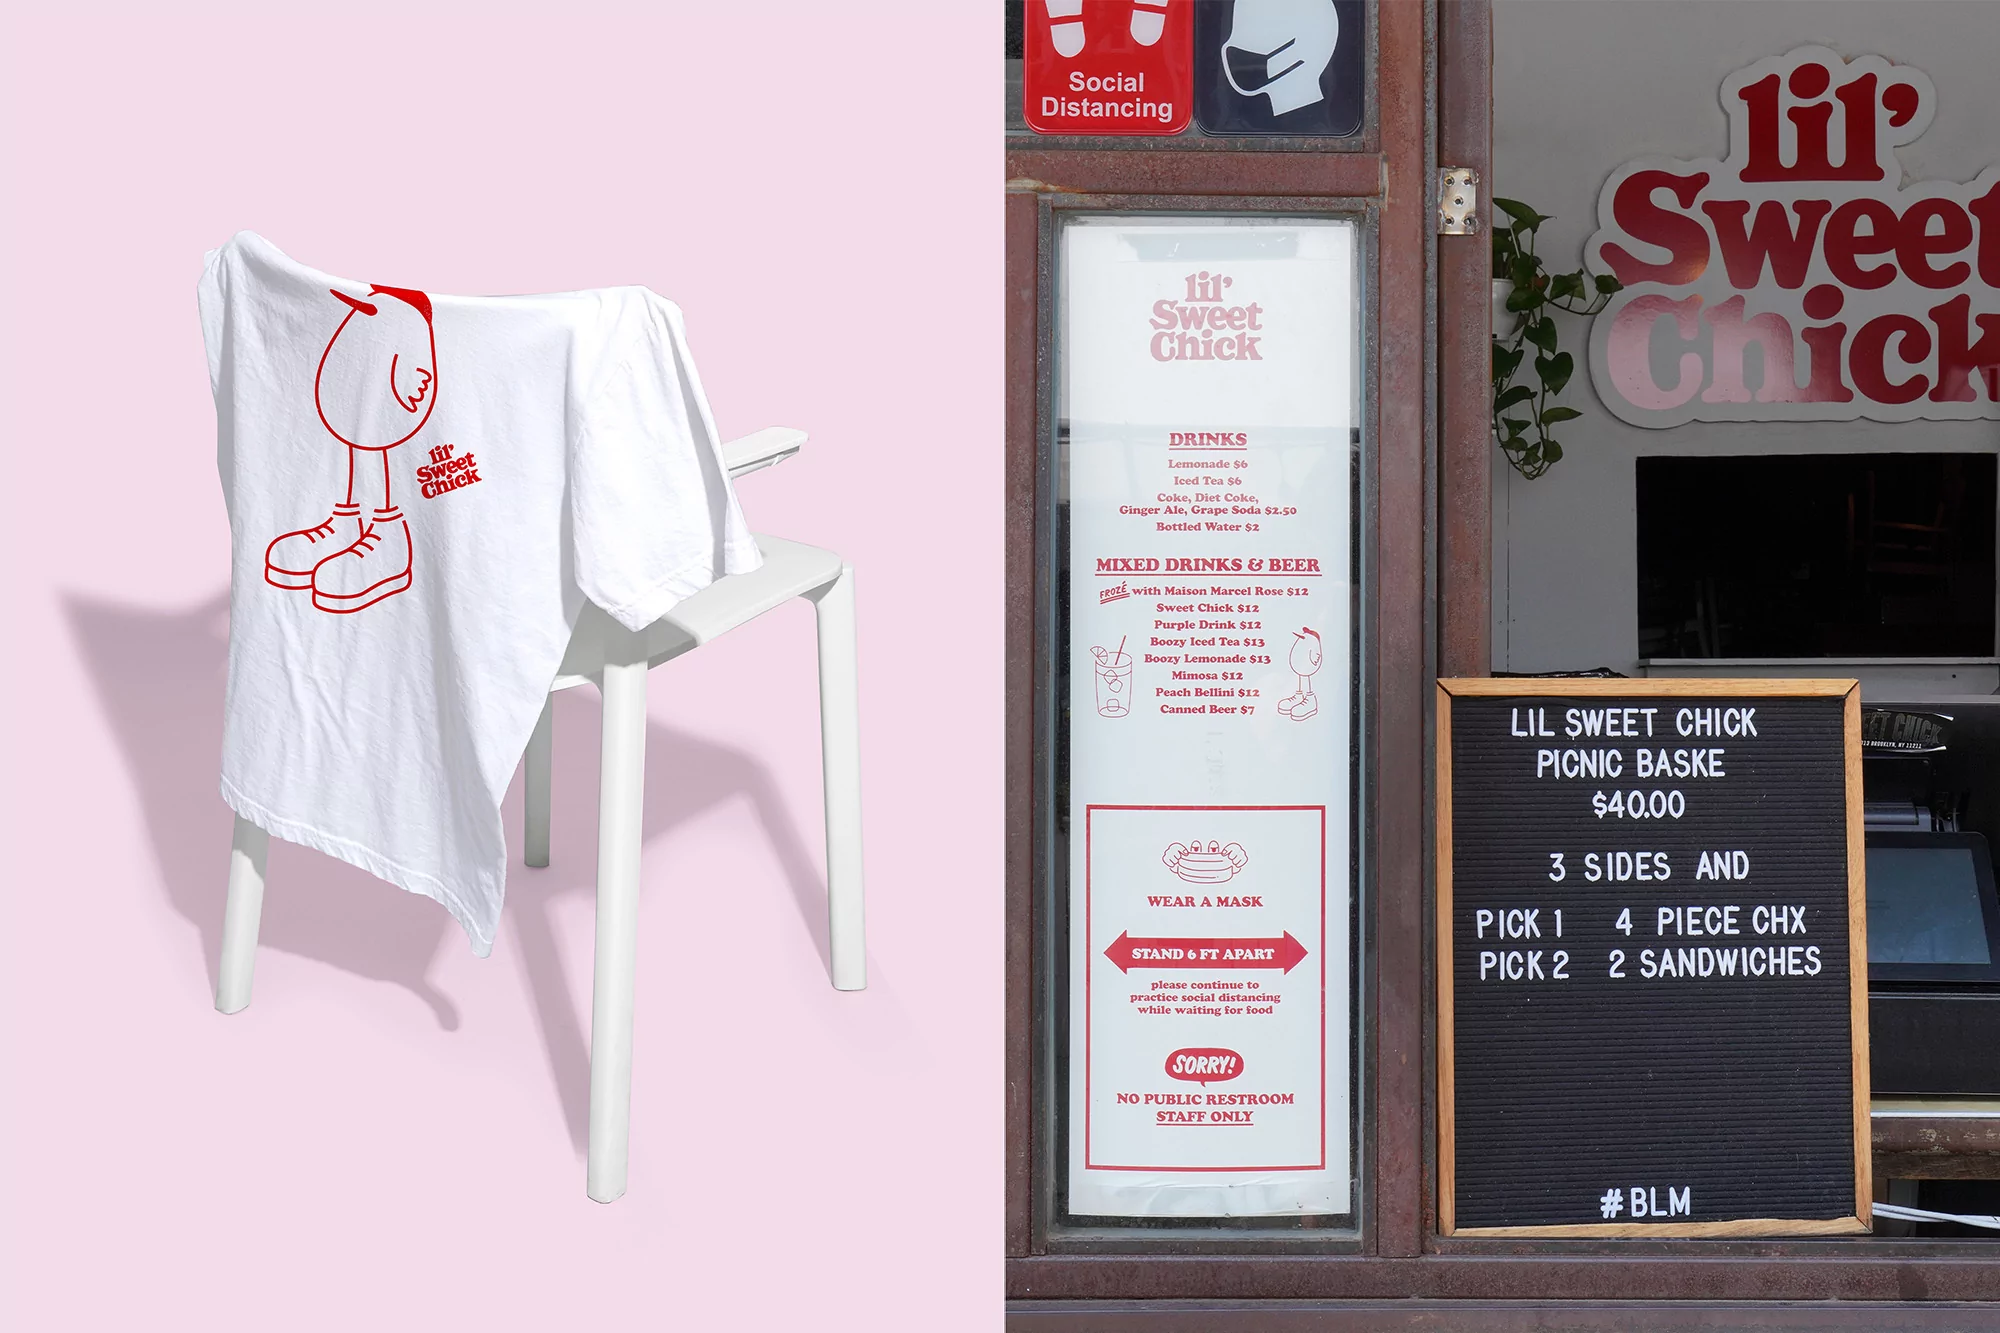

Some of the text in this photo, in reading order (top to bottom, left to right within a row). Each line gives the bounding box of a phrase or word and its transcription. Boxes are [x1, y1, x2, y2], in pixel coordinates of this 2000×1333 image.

[1070, 72, 1144, 92] Social
[1042, 96, 1172, 123] Distancing
[1149, 300, 1263, 330] Sweet
[1150, 330, 1262, 362] Chick
[1608, 284, 2000, 410] Chick
[1169, 433, 1247, 446] DRINKS
[417, 452, 476, 484] Sweet
[1168, 460, 1248, 469] Lemonade $6
[422, 469, 482, 499] Chick
[1174, 476, 1242, 486] Iced Tea $6
[1157, 493, 1259, 504] Coke, Diet Coke,
[1120, 506, 1296, 516] Ginger Ale, Grape Soda $2.50
[1157, 522, 1259, 532] Bottled Water $2
[1096, 558, 1320, 572] MIXED DRINKS & BEER
[1132, 587, 1161, 596] with
[1165, 587, 1206, 596] Maison
[1211, 587, 1251, 596] Marcel
[1255, 587, 1284, 596] Rose
[1287, 587, 1308, 596] $12
[1157, 604, 1259, 613] Sweet Chick $12
[1155, 620, 1261, 631] Purple Drink $12
[1150, 637, 1265, 648] Boozy Iced Tea $13
[1145, 654, 1271, 664] Boozy Lemonade $13
[1172, 671, 1242, 680] Mimosa $12
[1156, 688, 1260, 698] Peach Bellini $12
[1160, 704, 1254, 714] Canned Beer $7
[1512, 708, 1757, 740] LIL SWEET CHICK
[1863, 712, 1943, 744] EET CHICK
[1537, 749, 1725, 779] PICNIC BASKE
[1592, 790, 1685, 819] $40.00
[1549, 851, 1749, 882] 3 SIDES AND
[1148, 896, 1262, 907] WEAR A MASK
[1477, 905, 1806, 939] PICK 1 4 PIECE CHX
[1132, 948, 1274, 960] STAND 6 FT APART
[1481, 946, 1821, 981] PICK 2 2 SANDWICHES
[1152, 980, 1187, 991] please
[1191, 981, 1243, 989] continue
[1130, 994, 1280, 1004] practice social distancing
[1138, 1006, 1273, 1016] while waiting for food
[1172, 1055, 1235, 1075] SORRY!
[1118, 1093, 1294, 1105] NO PUBLIC RESTROOM
[1157, 1111, 1253, 1122] STAFF ONLY
